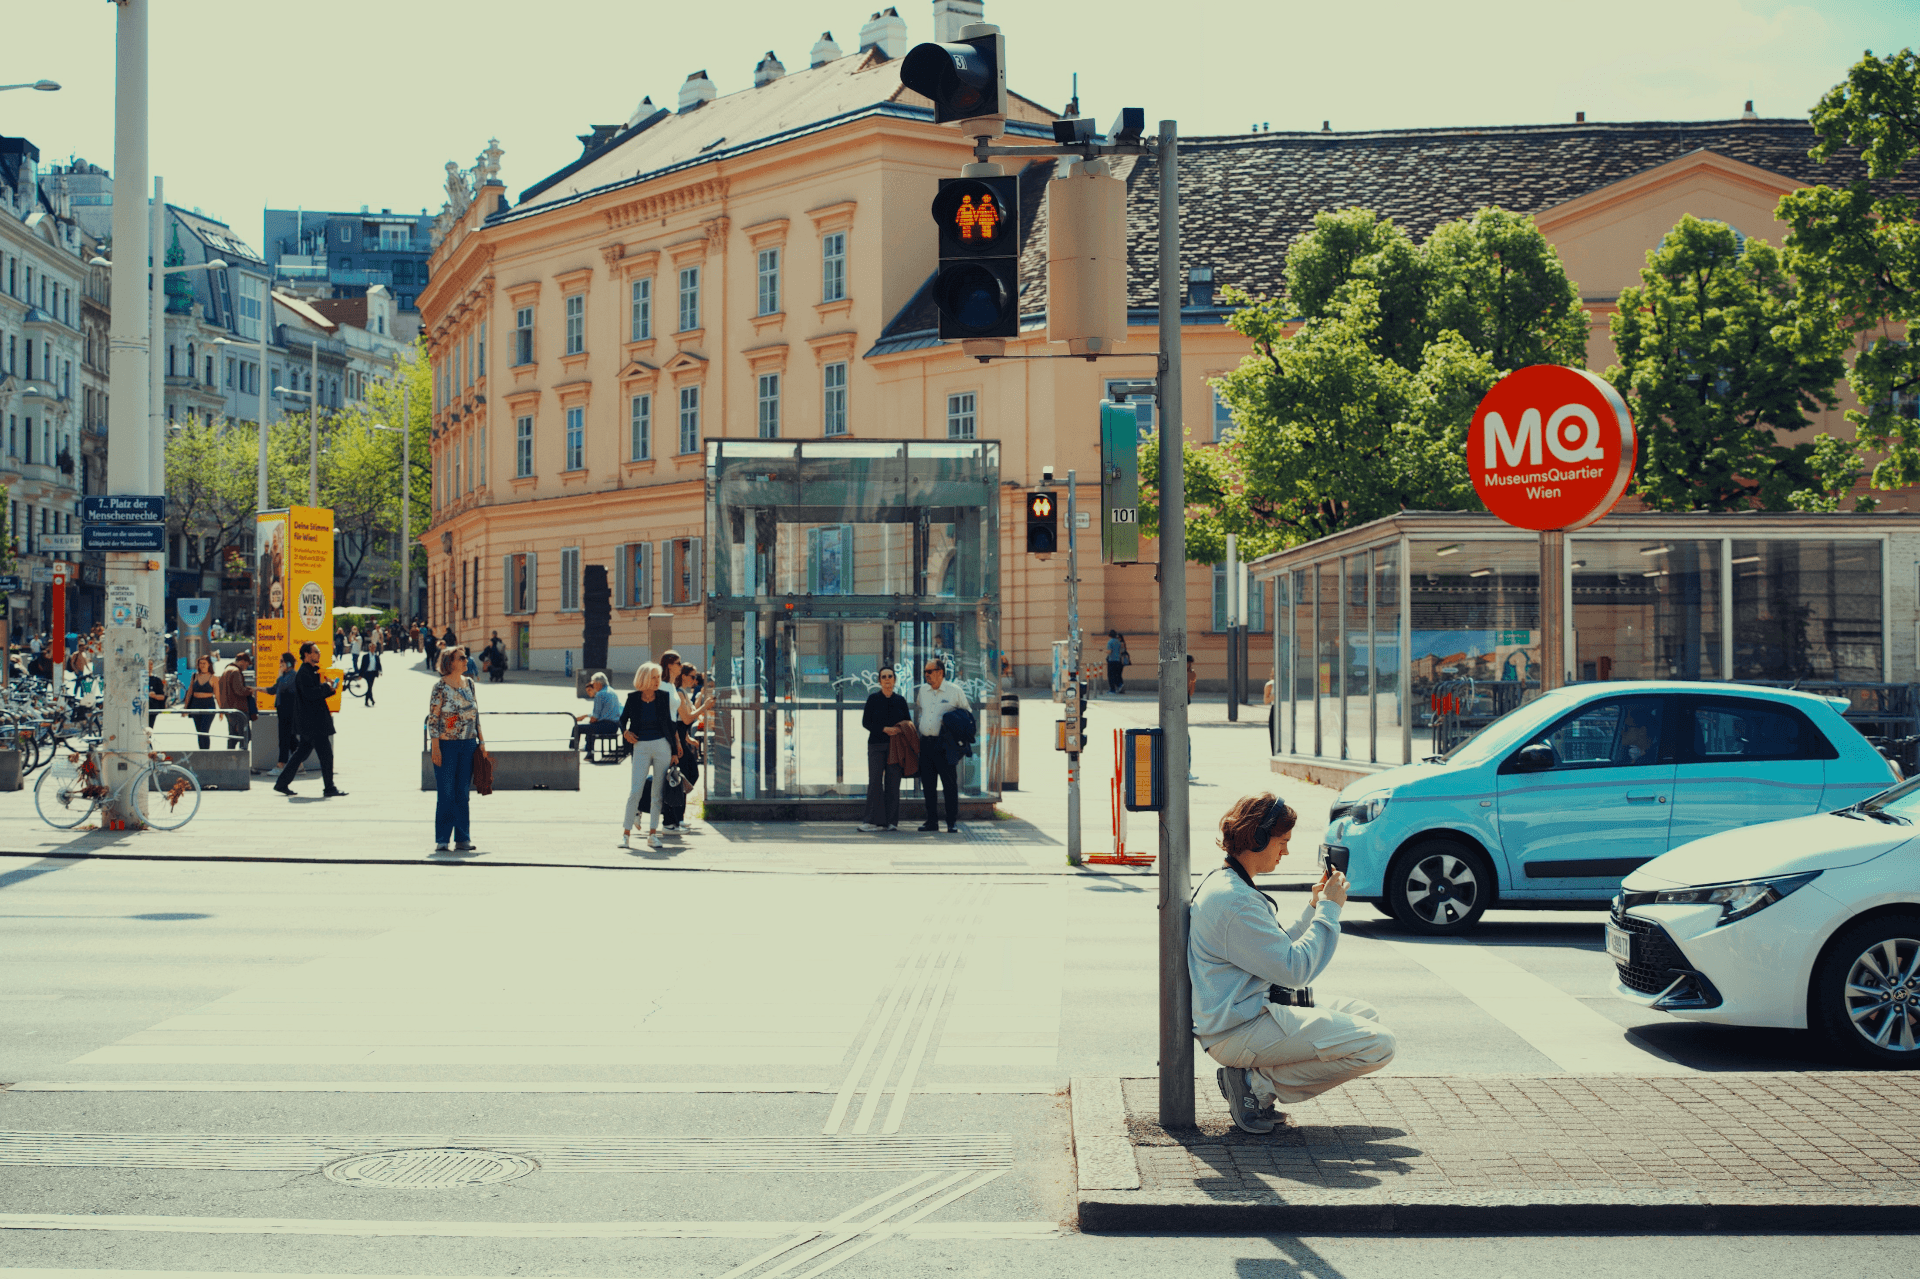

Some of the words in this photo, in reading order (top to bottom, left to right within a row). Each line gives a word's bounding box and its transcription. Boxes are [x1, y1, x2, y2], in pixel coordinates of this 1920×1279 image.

[1484, 403, 1604, 469] MQ
[1485, 465, 1604, 487] MuseumsQuartier
[1526, 485, 1561, 500] Wien
[110, 498, 131, 508] Platz
[133, 498, 149, 508] der
[88, 510, 158, 520] Menschenrechte
[1113, 509, 1134, 522] 101
[294, 521, 309, 530] Deine
[310, 522, 329, 532] Stimme
[302, 594, 323, 605] WIEN
